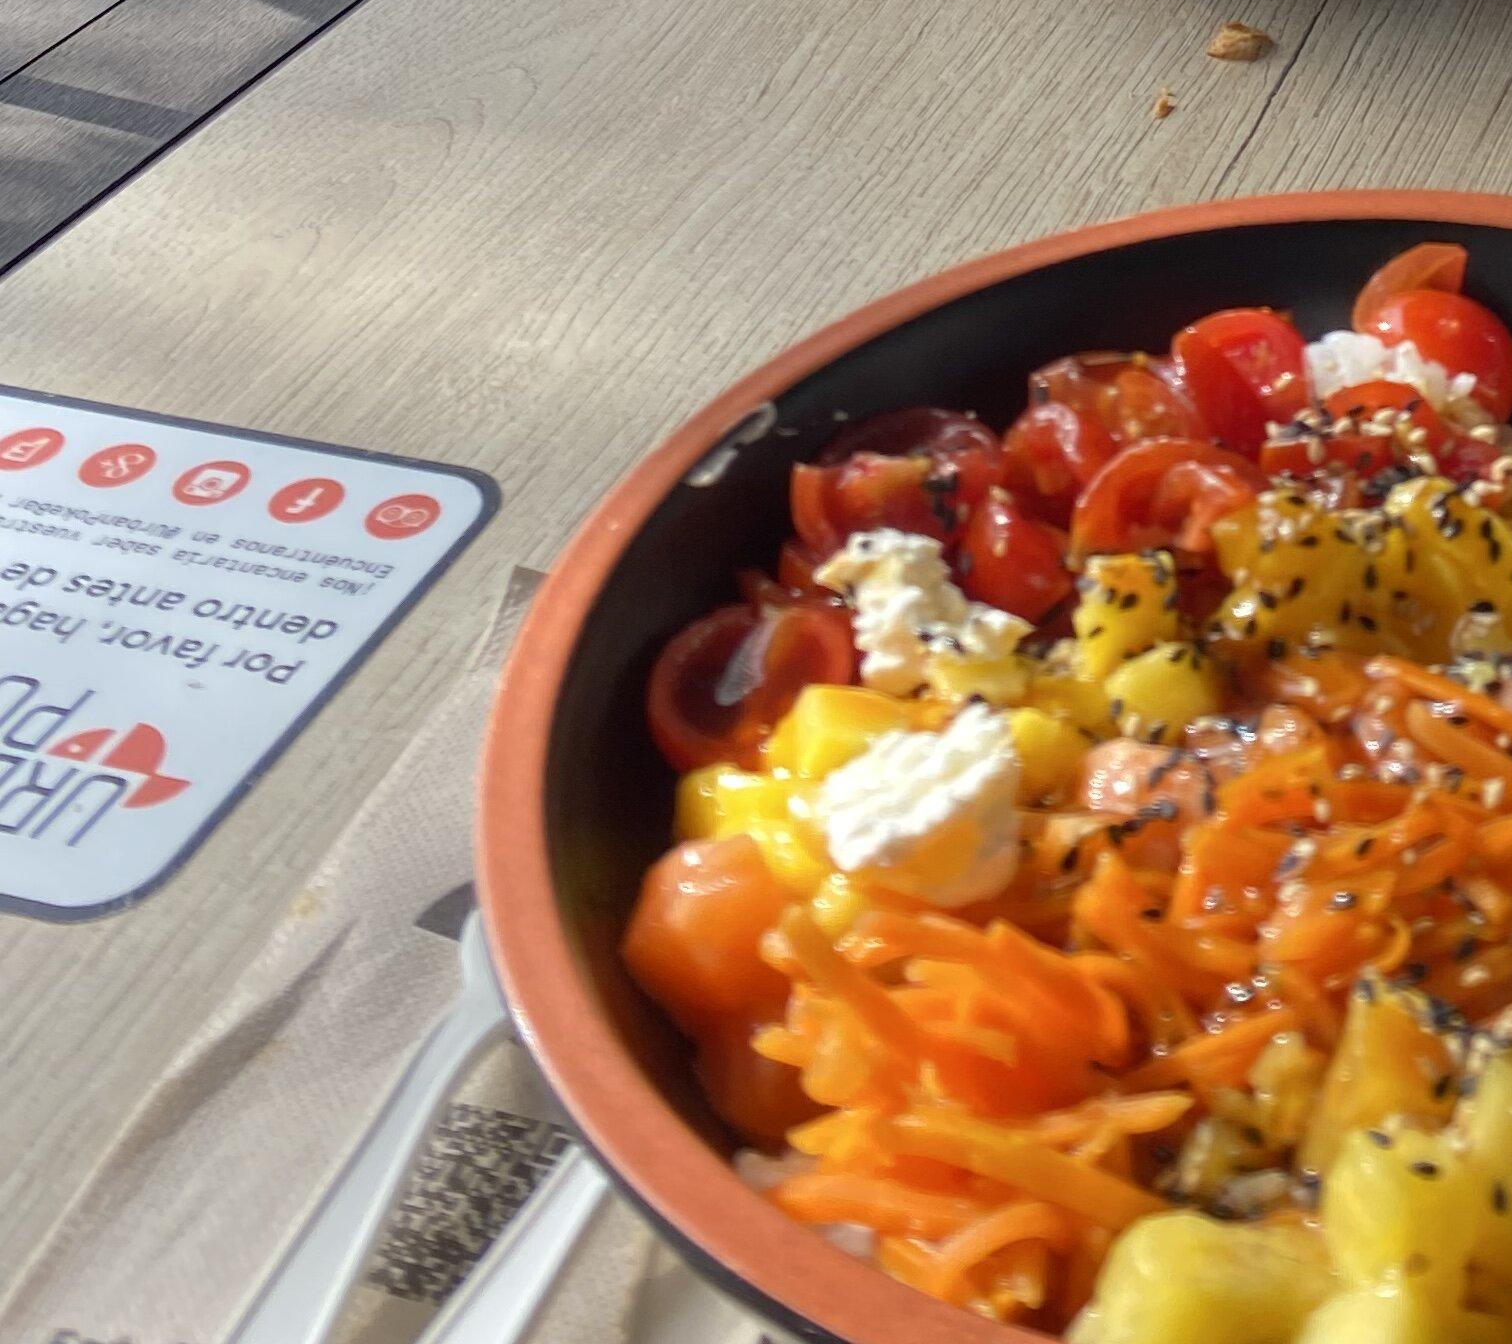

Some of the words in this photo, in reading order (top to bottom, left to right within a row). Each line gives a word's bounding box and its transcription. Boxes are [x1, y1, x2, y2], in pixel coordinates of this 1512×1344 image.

[90, 536, 163, 556] saber
[190, 531, 221, 544] en
[0, 563, 58, 592] de
[62, 574, 186, 614] antes
[0, 601, 87, 645] hag
[192, 599, 339, 644] dentro
[98, 620, 221, 670] favor,
[222, 649, 306, 685] Por
